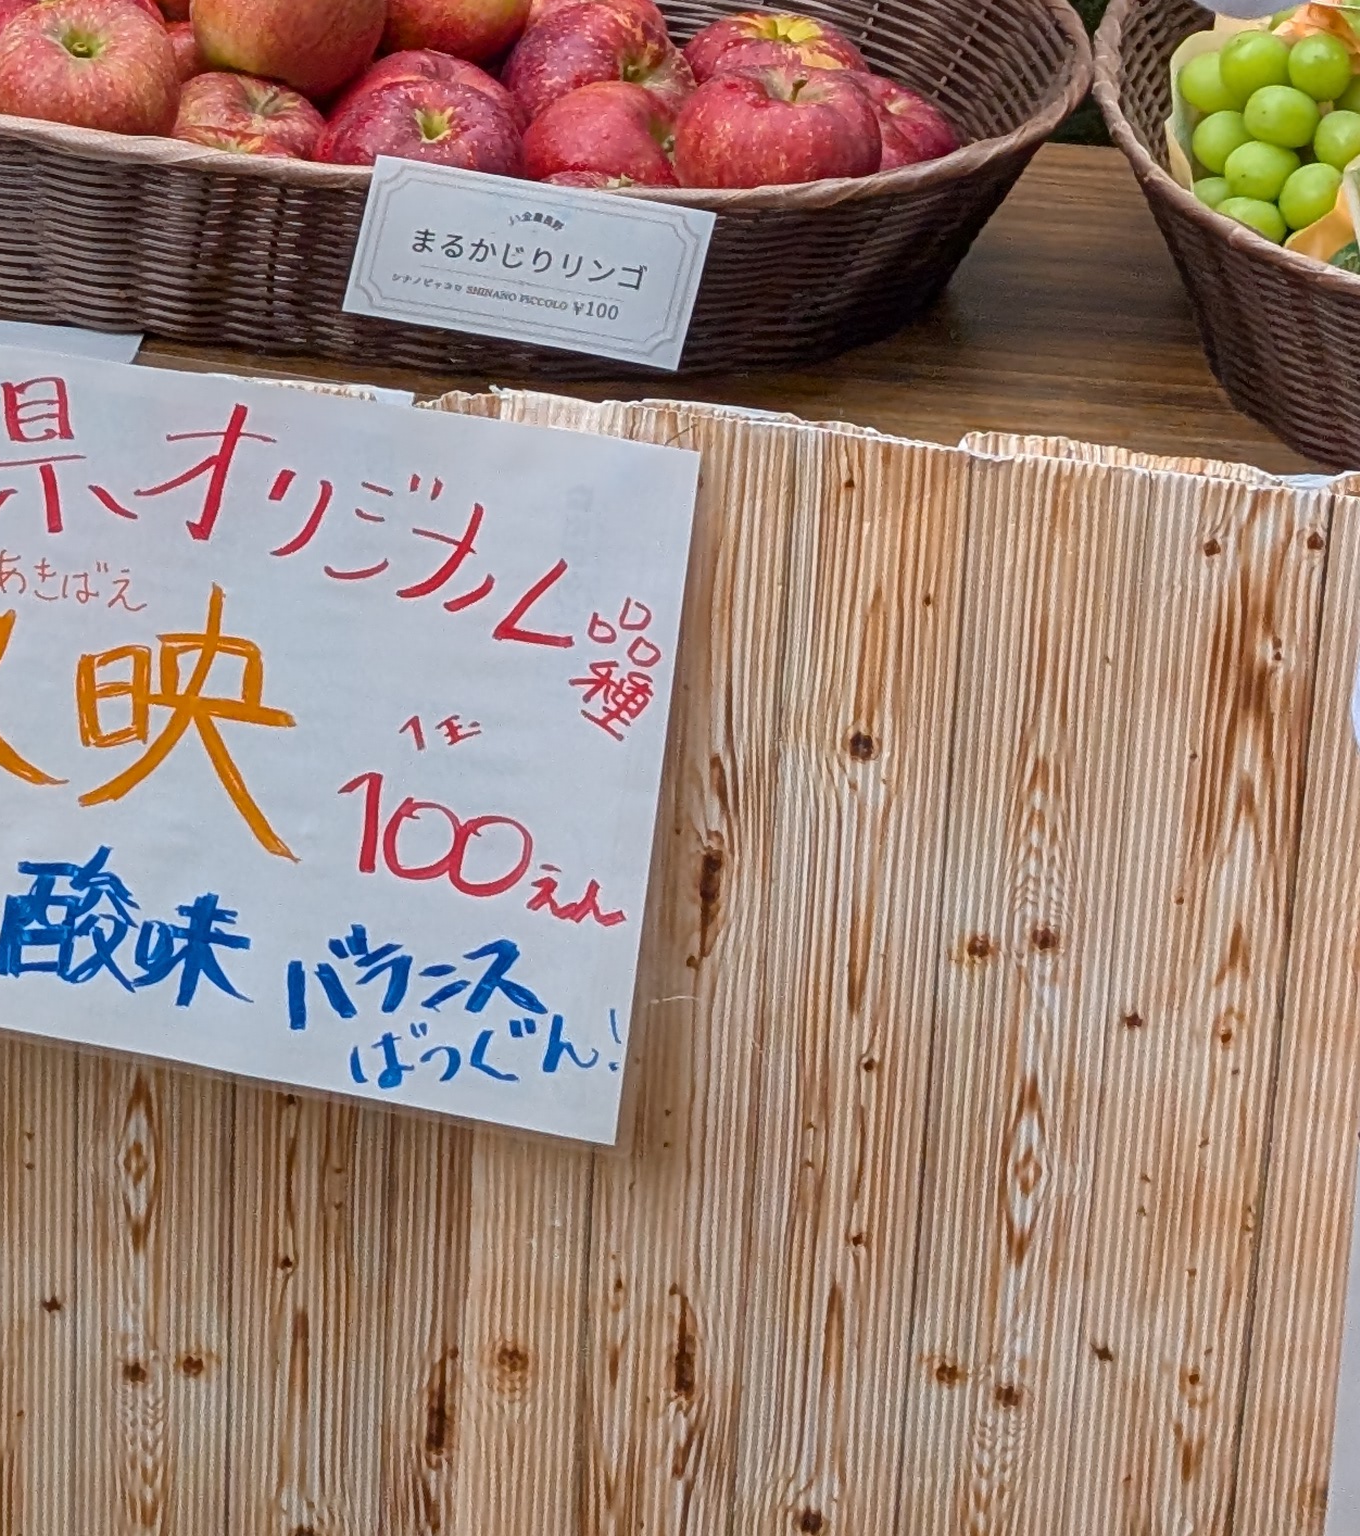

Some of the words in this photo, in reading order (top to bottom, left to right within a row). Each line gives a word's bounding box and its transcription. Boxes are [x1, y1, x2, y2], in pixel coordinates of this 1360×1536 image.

[411, 227, 649, 291] まるかじりリンゴ
[465, 284, 518, 303] SHINANO
[519, 292, 568, 312] PICCOLO
[572, 299, 620, 322] ¥100
[338, 771, 627, 927] 100えん
